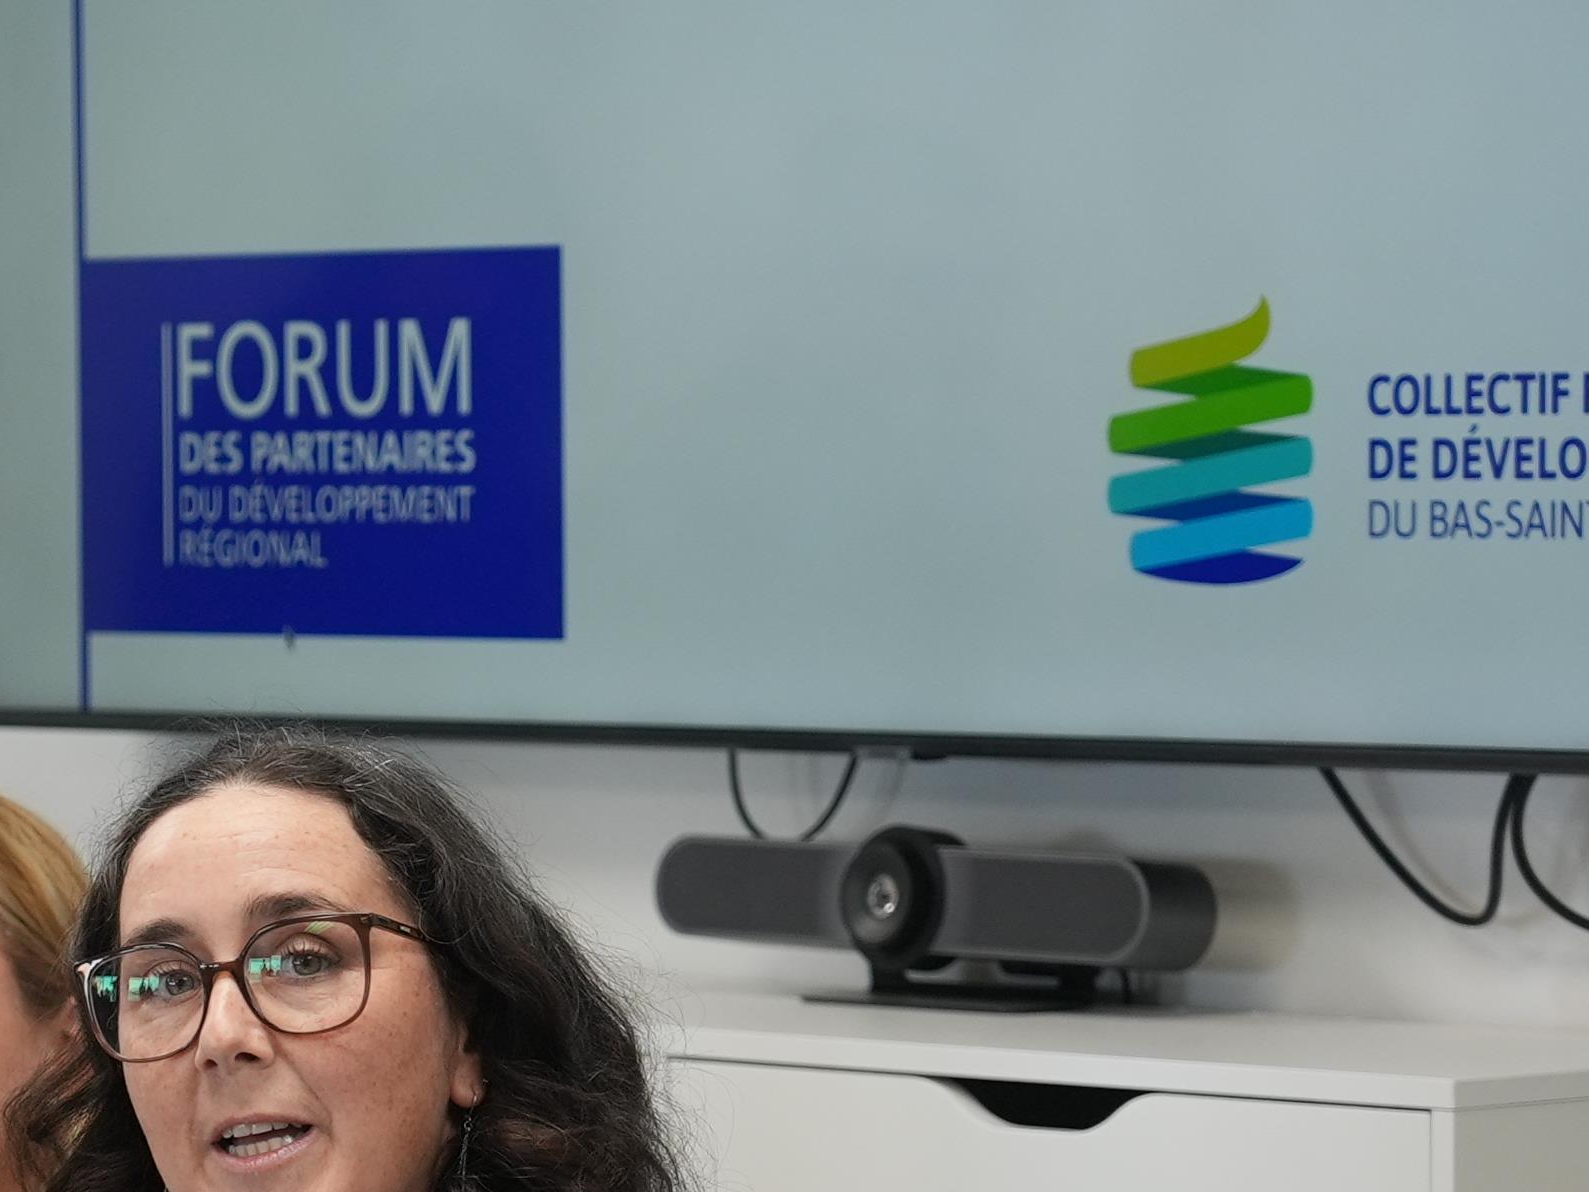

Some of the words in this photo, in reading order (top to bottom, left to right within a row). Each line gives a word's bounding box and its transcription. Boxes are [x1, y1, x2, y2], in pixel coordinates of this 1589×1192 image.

[177, 317, 473, 419] FORUM
[1368, 372, 1570, 416] COLLECTIF
[179, 430, 243, 475] DES
[251, 429, 476, 474] PARTENAIRES
[1368, 437, 1419, 480] DE
[1431, 424, 1588, 480] DÉVELO
[179, 485, 223, 523] DU
[228, 478, 475, 523] DÉVELOPPEMENT
[1368, 500, 1417, 539] DU
[1429, 499, 1589, 540] BAS-SAIN
[179, 523, 328, 569] RÉGIONAL
